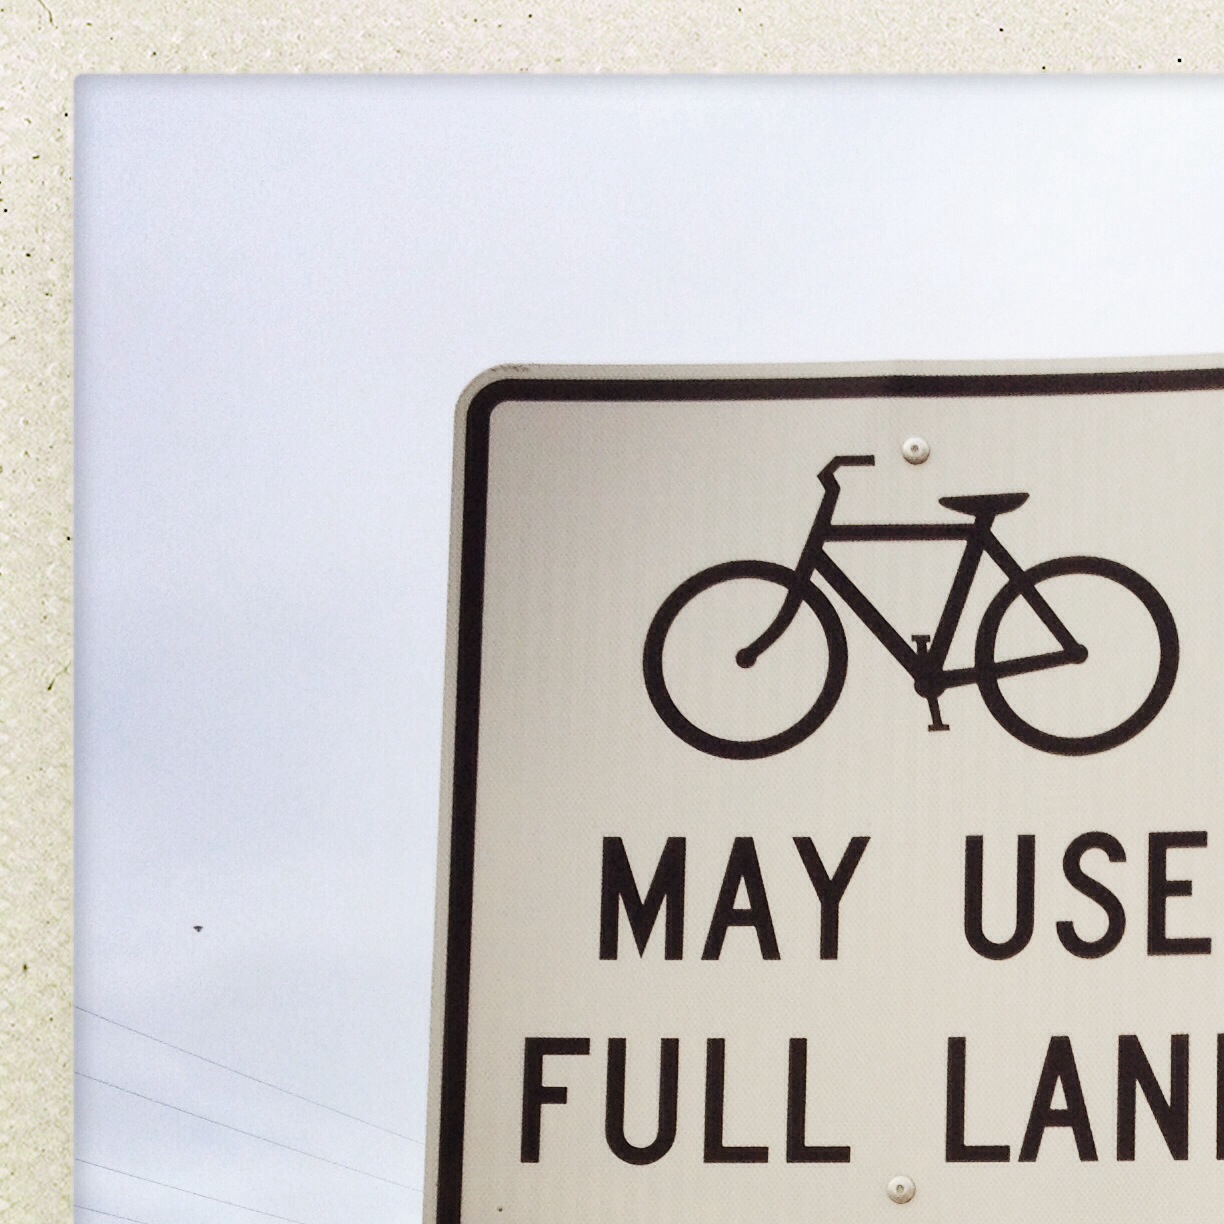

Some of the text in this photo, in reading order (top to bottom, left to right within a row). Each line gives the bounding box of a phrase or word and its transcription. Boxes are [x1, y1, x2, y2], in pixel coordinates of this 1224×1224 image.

[599, 831, 1211, 960] MAY USE
[521, 1036, 850, 1165] FULL
